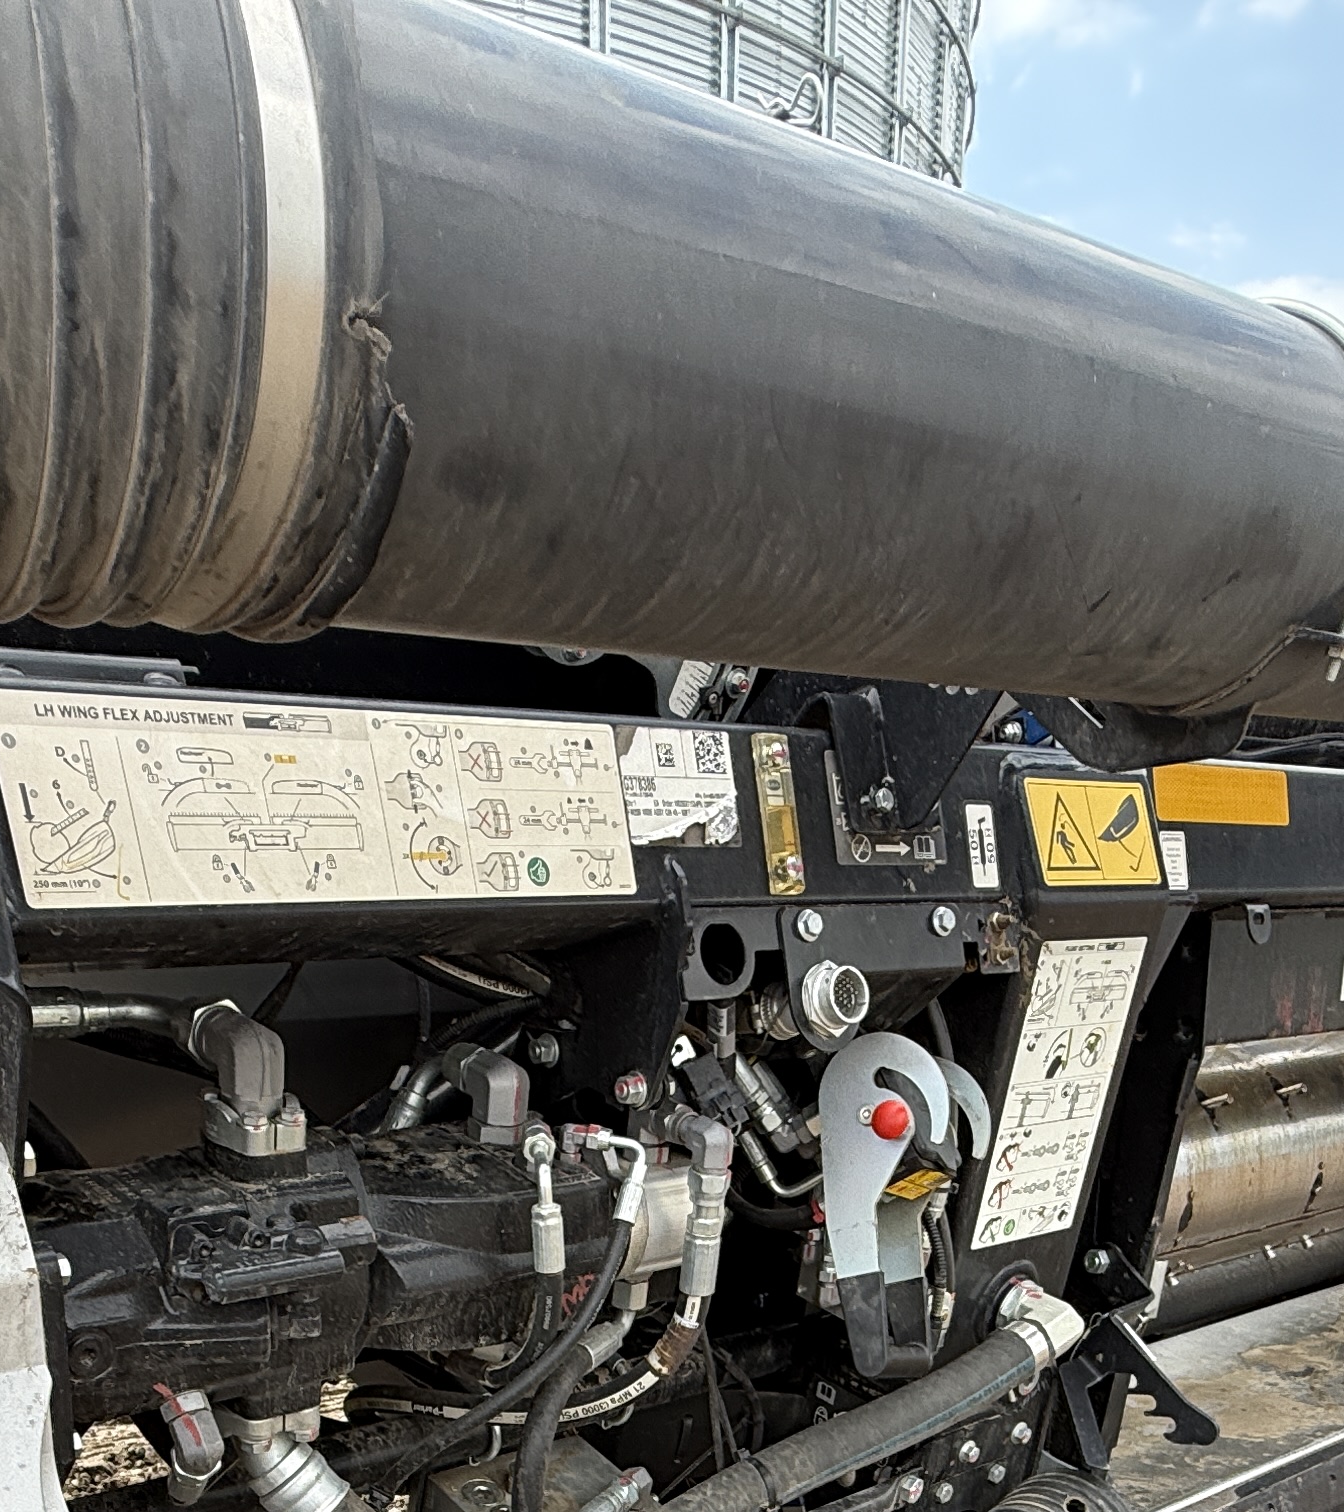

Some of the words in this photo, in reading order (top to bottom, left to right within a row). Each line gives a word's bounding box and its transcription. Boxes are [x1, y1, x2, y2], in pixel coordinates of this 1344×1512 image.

[33, 703, 55, 718] LH
[57, 704, 100, 720] WING
[102, 707, 141, 722] FLEX
[143, 709, 235, 727] ADJUSTMENT
[54, 746, 66, 757] D
[51, 779, 61, 790] 6
[33, 879, 49, 889] 250
[635, 1381, 646, 1393] 21
[609, 1389, 635, 1405] MPa
[413, 1404, 439, 1415] Parker
[582, 1402, 610, 1417] (3000
